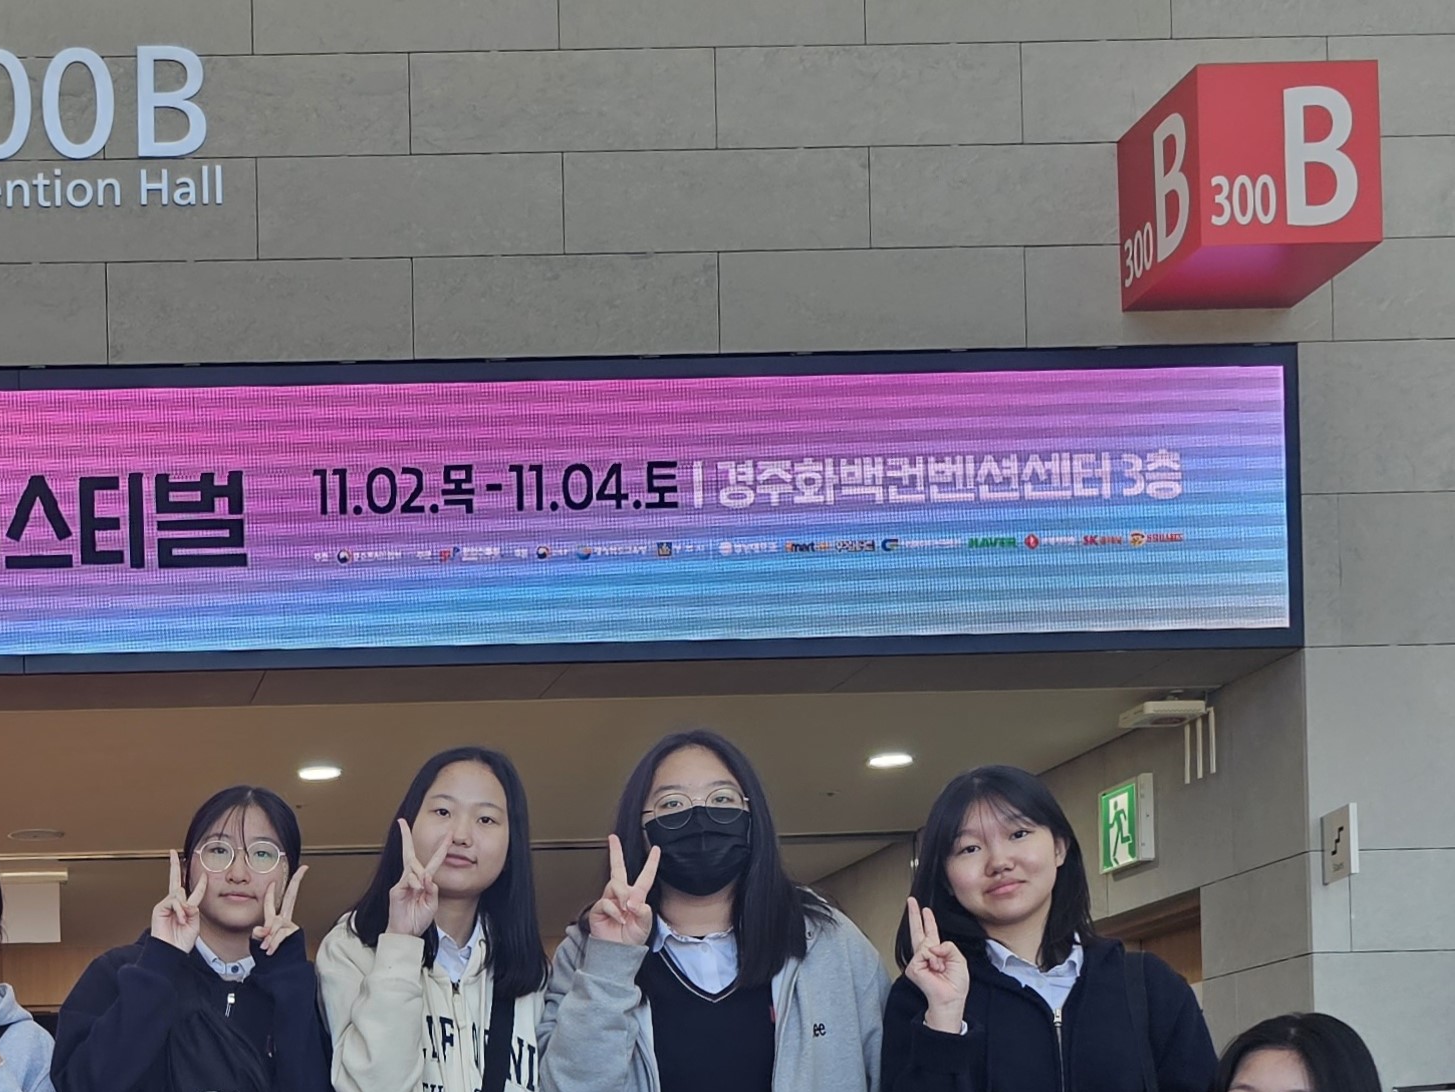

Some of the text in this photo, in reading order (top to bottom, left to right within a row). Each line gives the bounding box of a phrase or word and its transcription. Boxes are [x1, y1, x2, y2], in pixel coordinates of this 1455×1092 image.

[139, 164, 223, 207] Hall
[716, 451, 1112, 509] 경주화백컨벤션센터
[1120, 448, 1183, 501] 3층
